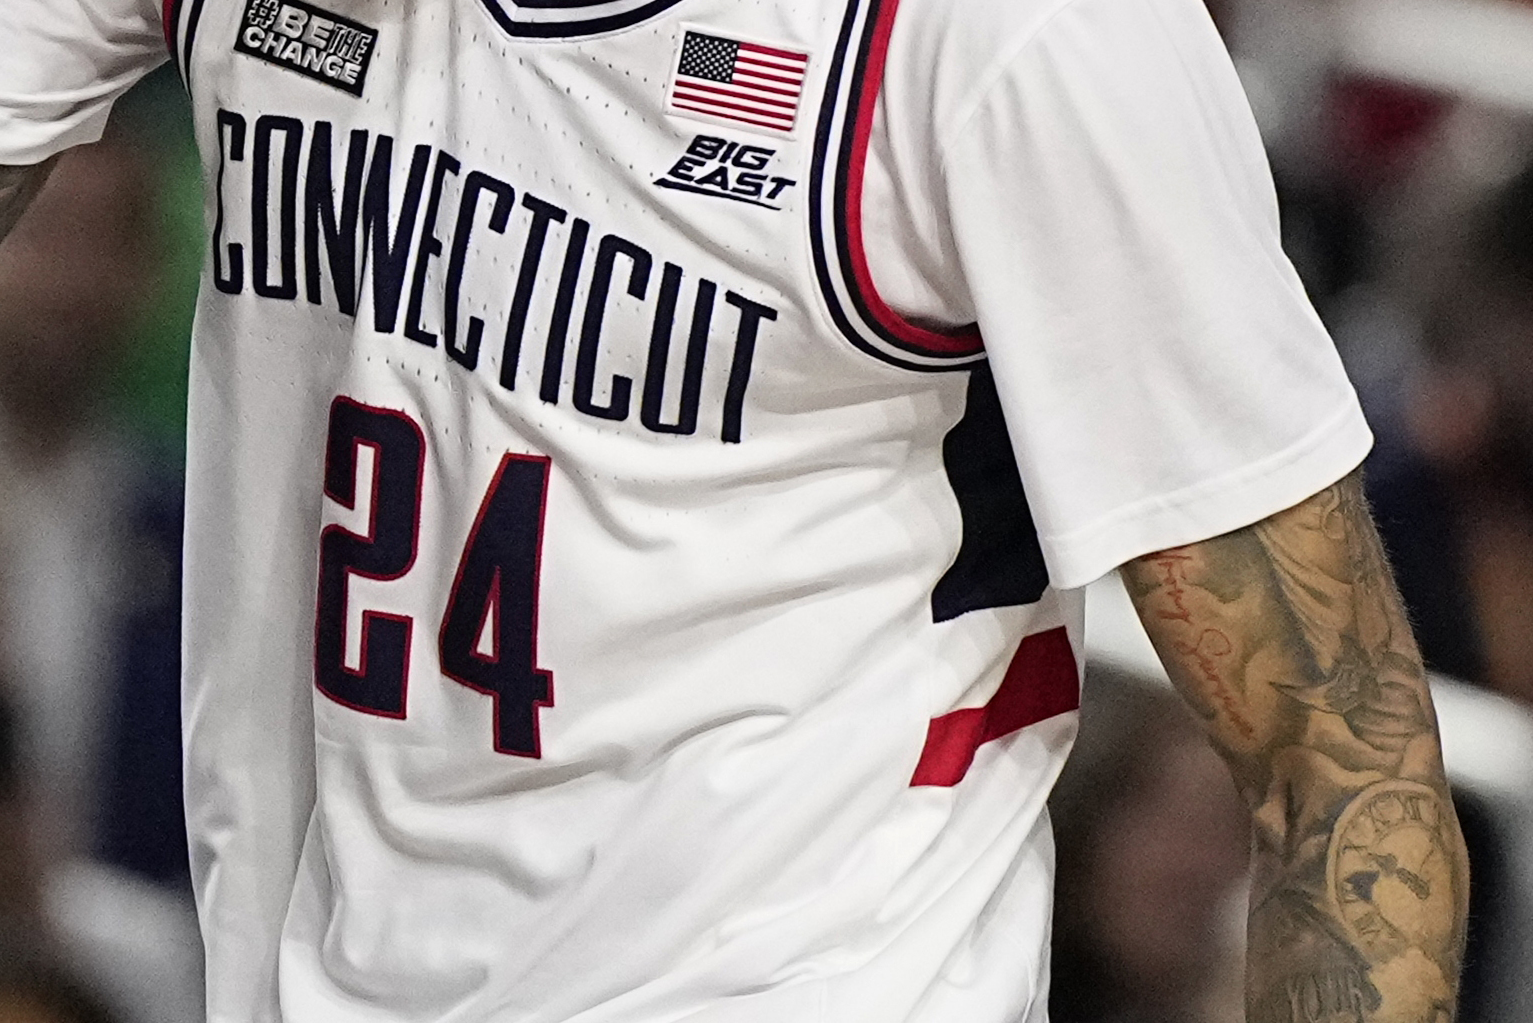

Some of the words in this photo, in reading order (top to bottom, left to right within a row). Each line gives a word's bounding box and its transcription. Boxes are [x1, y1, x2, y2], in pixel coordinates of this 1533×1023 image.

[242, 25, 362, 85] CHANGE
[667, 155, 797, 200] EAST
[685, 134, 777, 171] BIG
[212, 108, 778, 445] CONNECTICUT
[314, 394, 555, 760] 24
